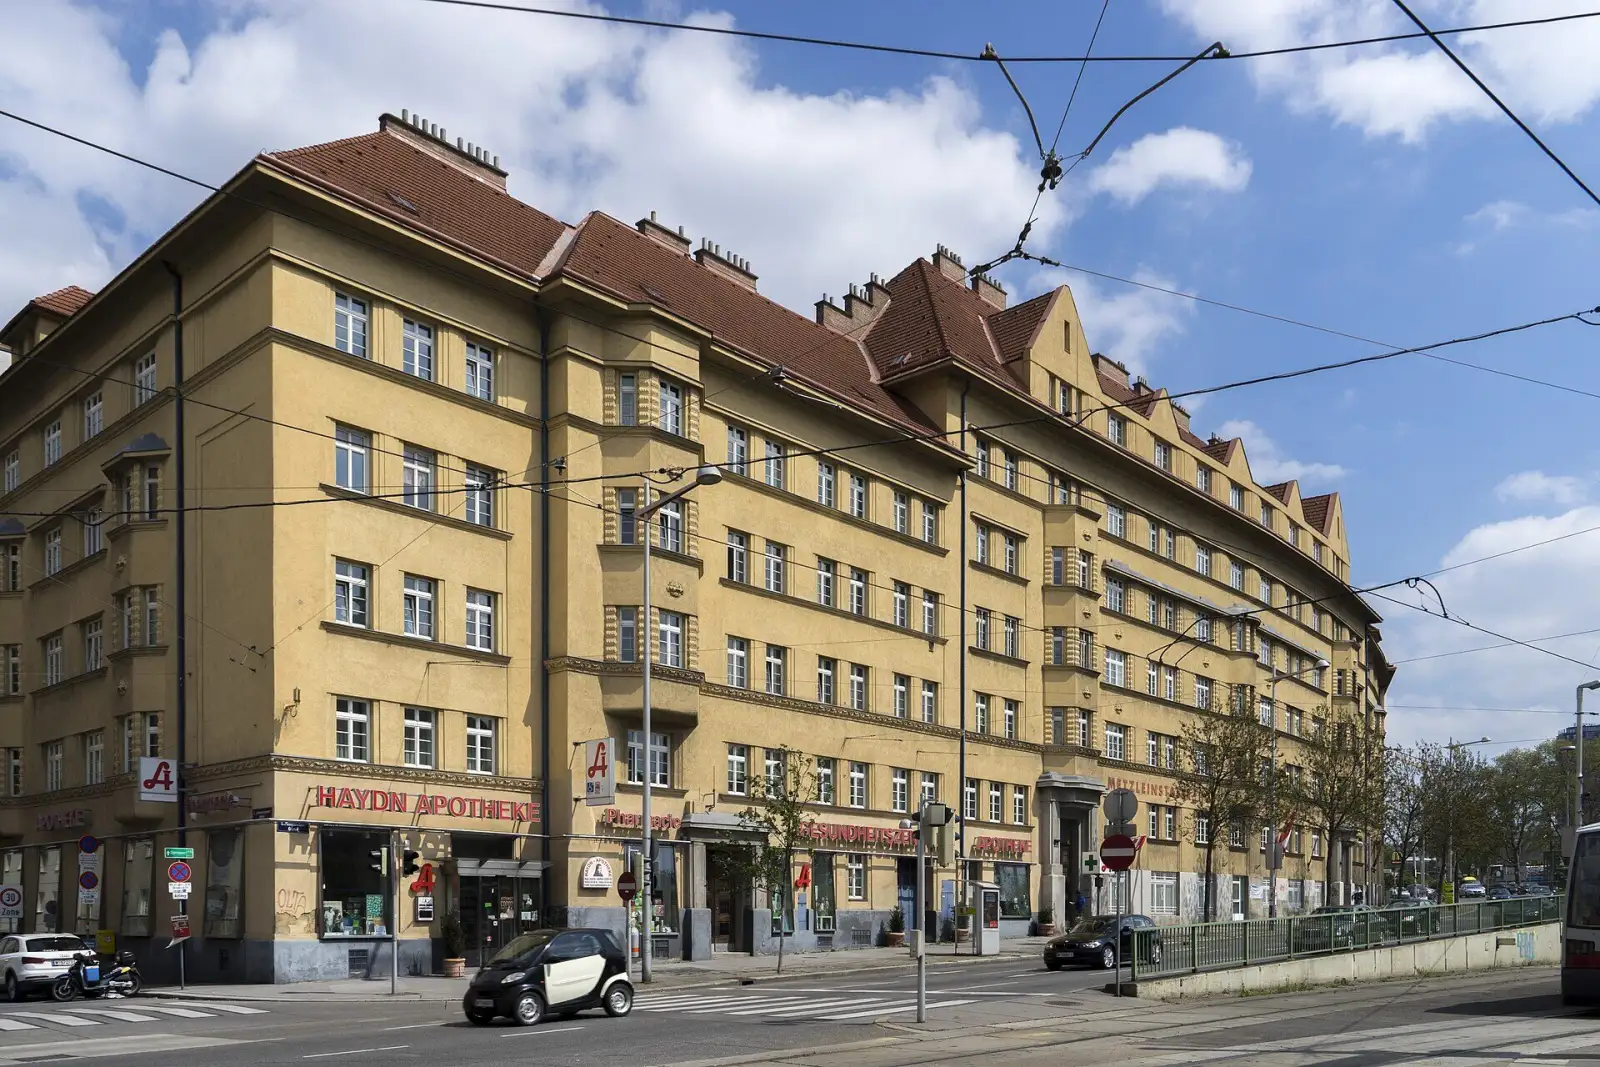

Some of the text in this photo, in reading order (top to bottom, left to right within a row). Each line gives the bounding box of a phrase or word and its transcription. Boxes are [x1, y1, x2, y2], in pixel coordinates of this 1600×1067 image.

[317, 785, 541, 822] HAYDN APOTHEKE
[608, 808, 681, 829] Pharacie
[976, 836, 1032, 852] APOTHEKE
[5, 892, 16, 902] 30
[1, 907, 20, 916] Zone
